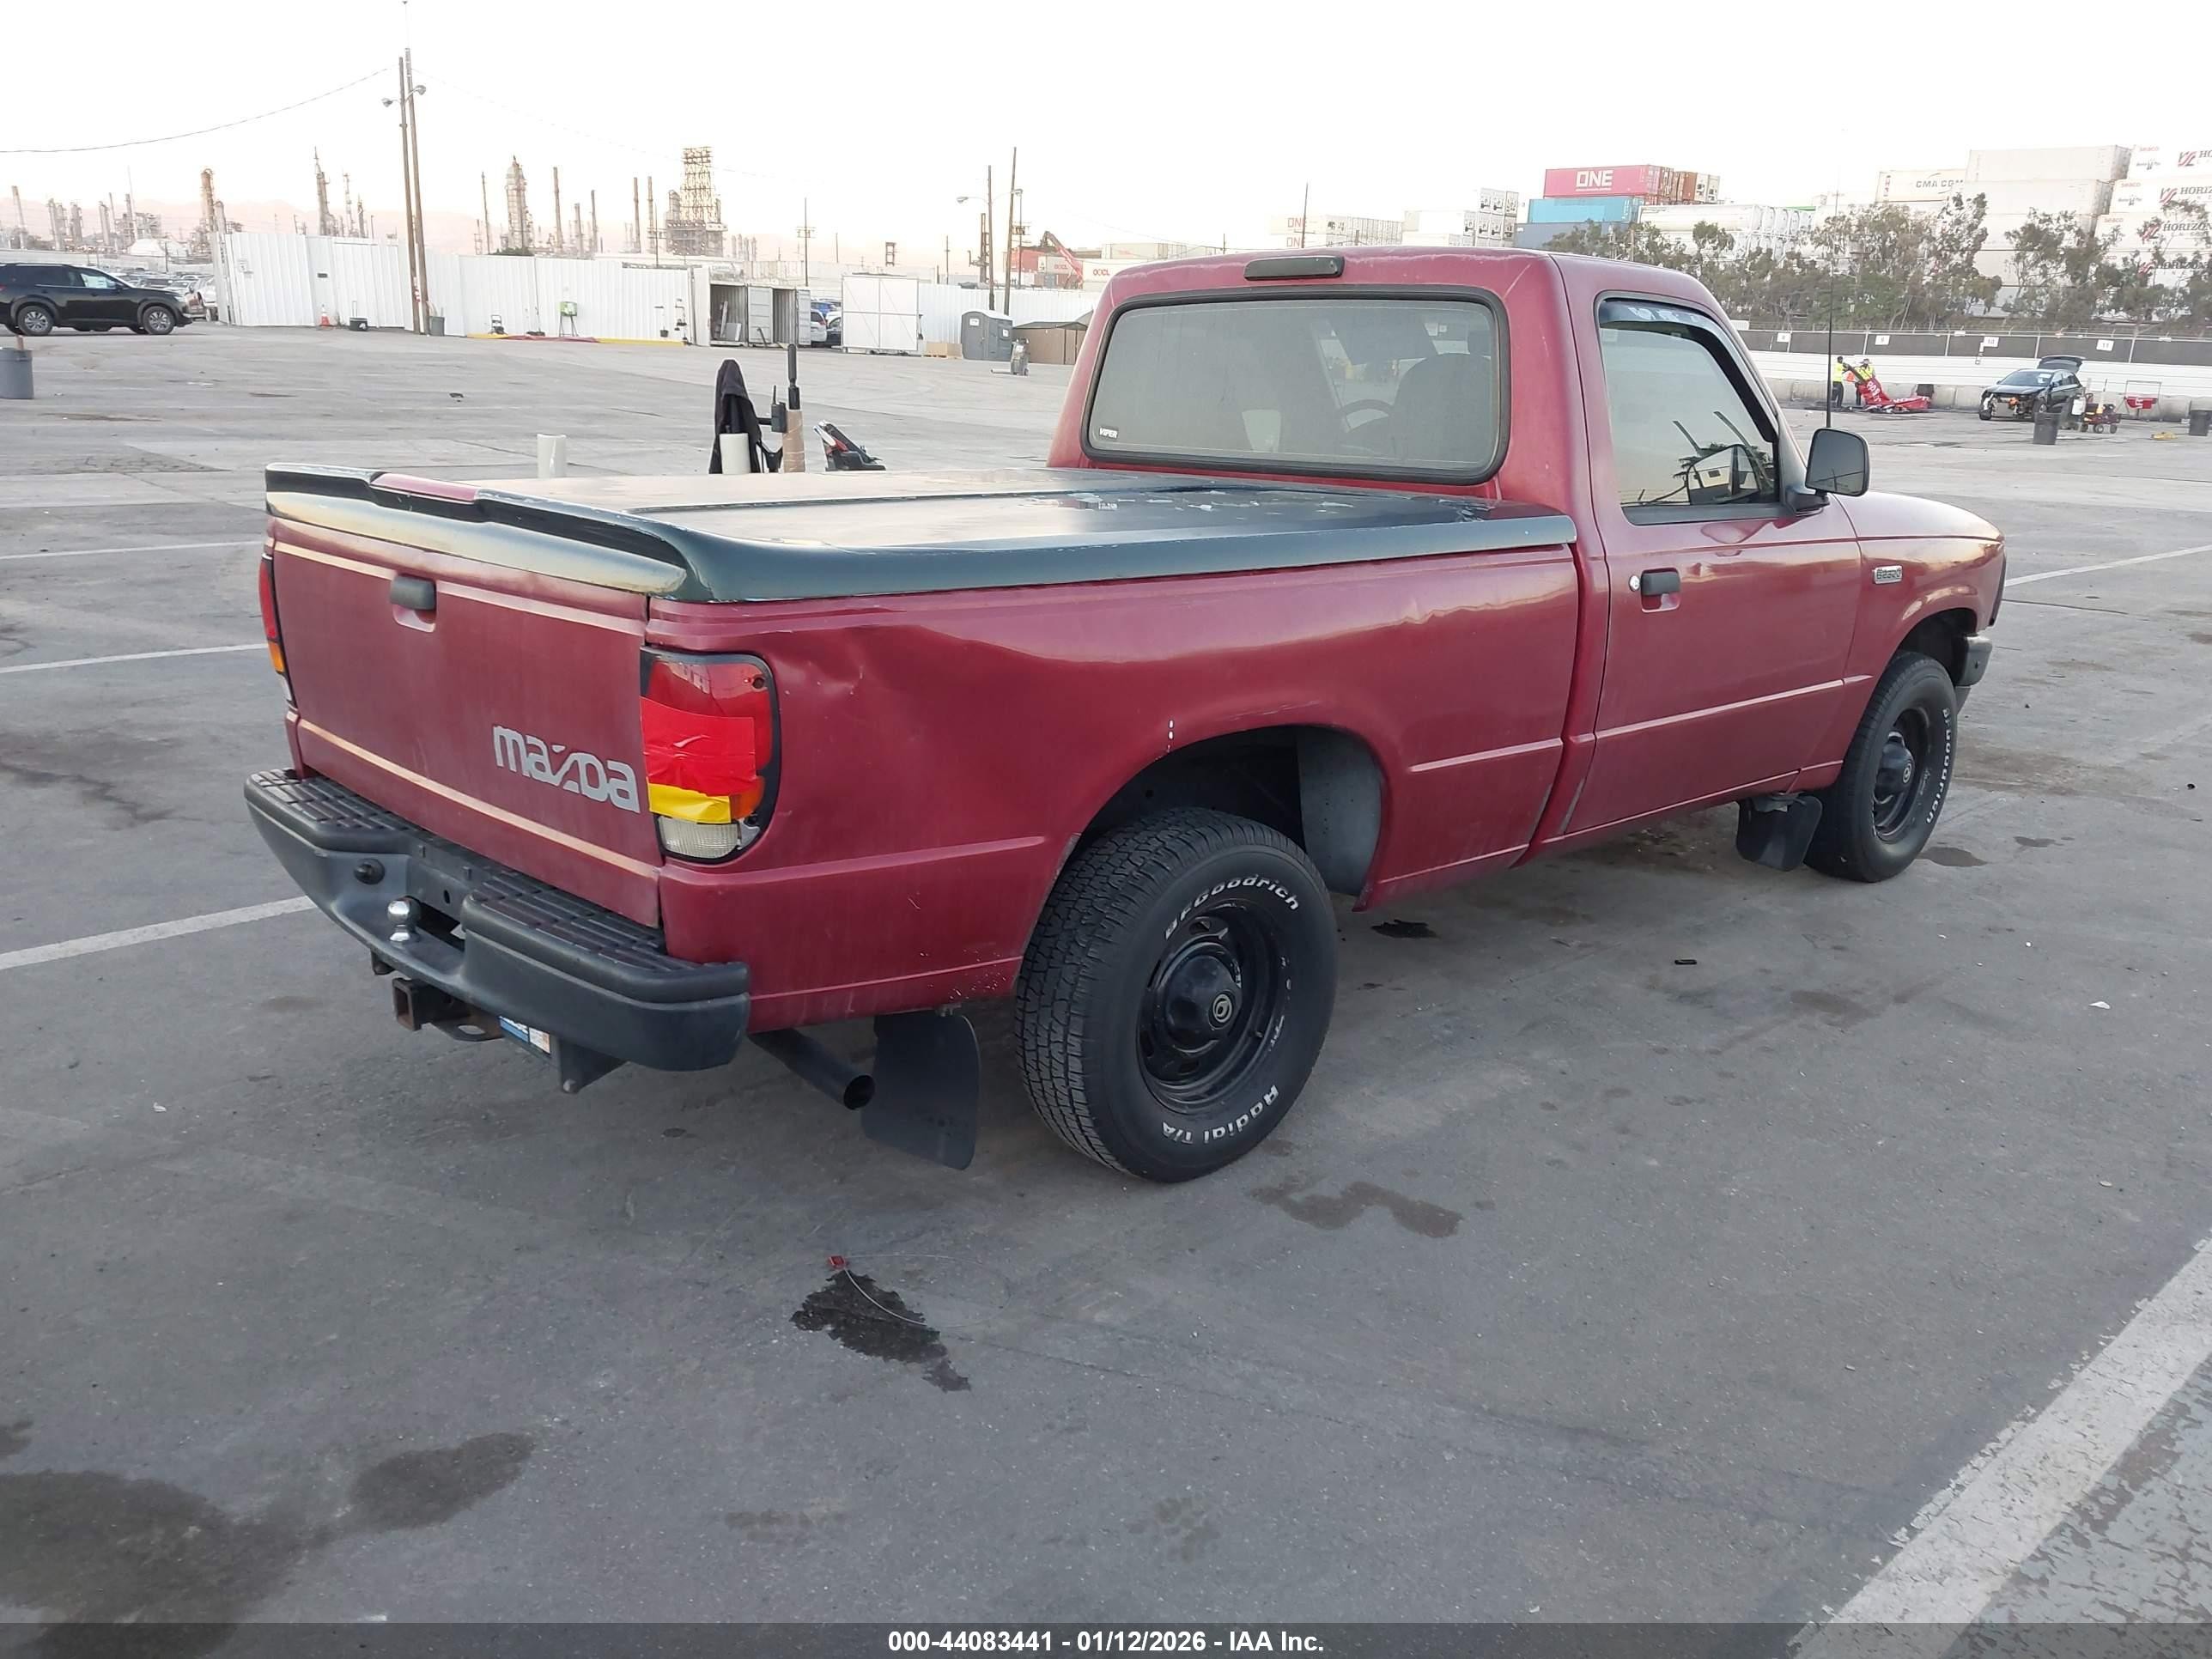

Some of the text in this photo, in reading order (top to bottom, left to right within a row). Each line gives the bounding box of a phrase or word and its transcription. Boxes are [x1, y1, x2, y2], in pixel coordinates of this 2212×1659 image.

[1576, 170, 1613, 186] ONE
[1092, 268, 1110, 276] OOCL
[493, 726, 641, 813] mazda
[1204, 1085, 1279, 1144] Radial
